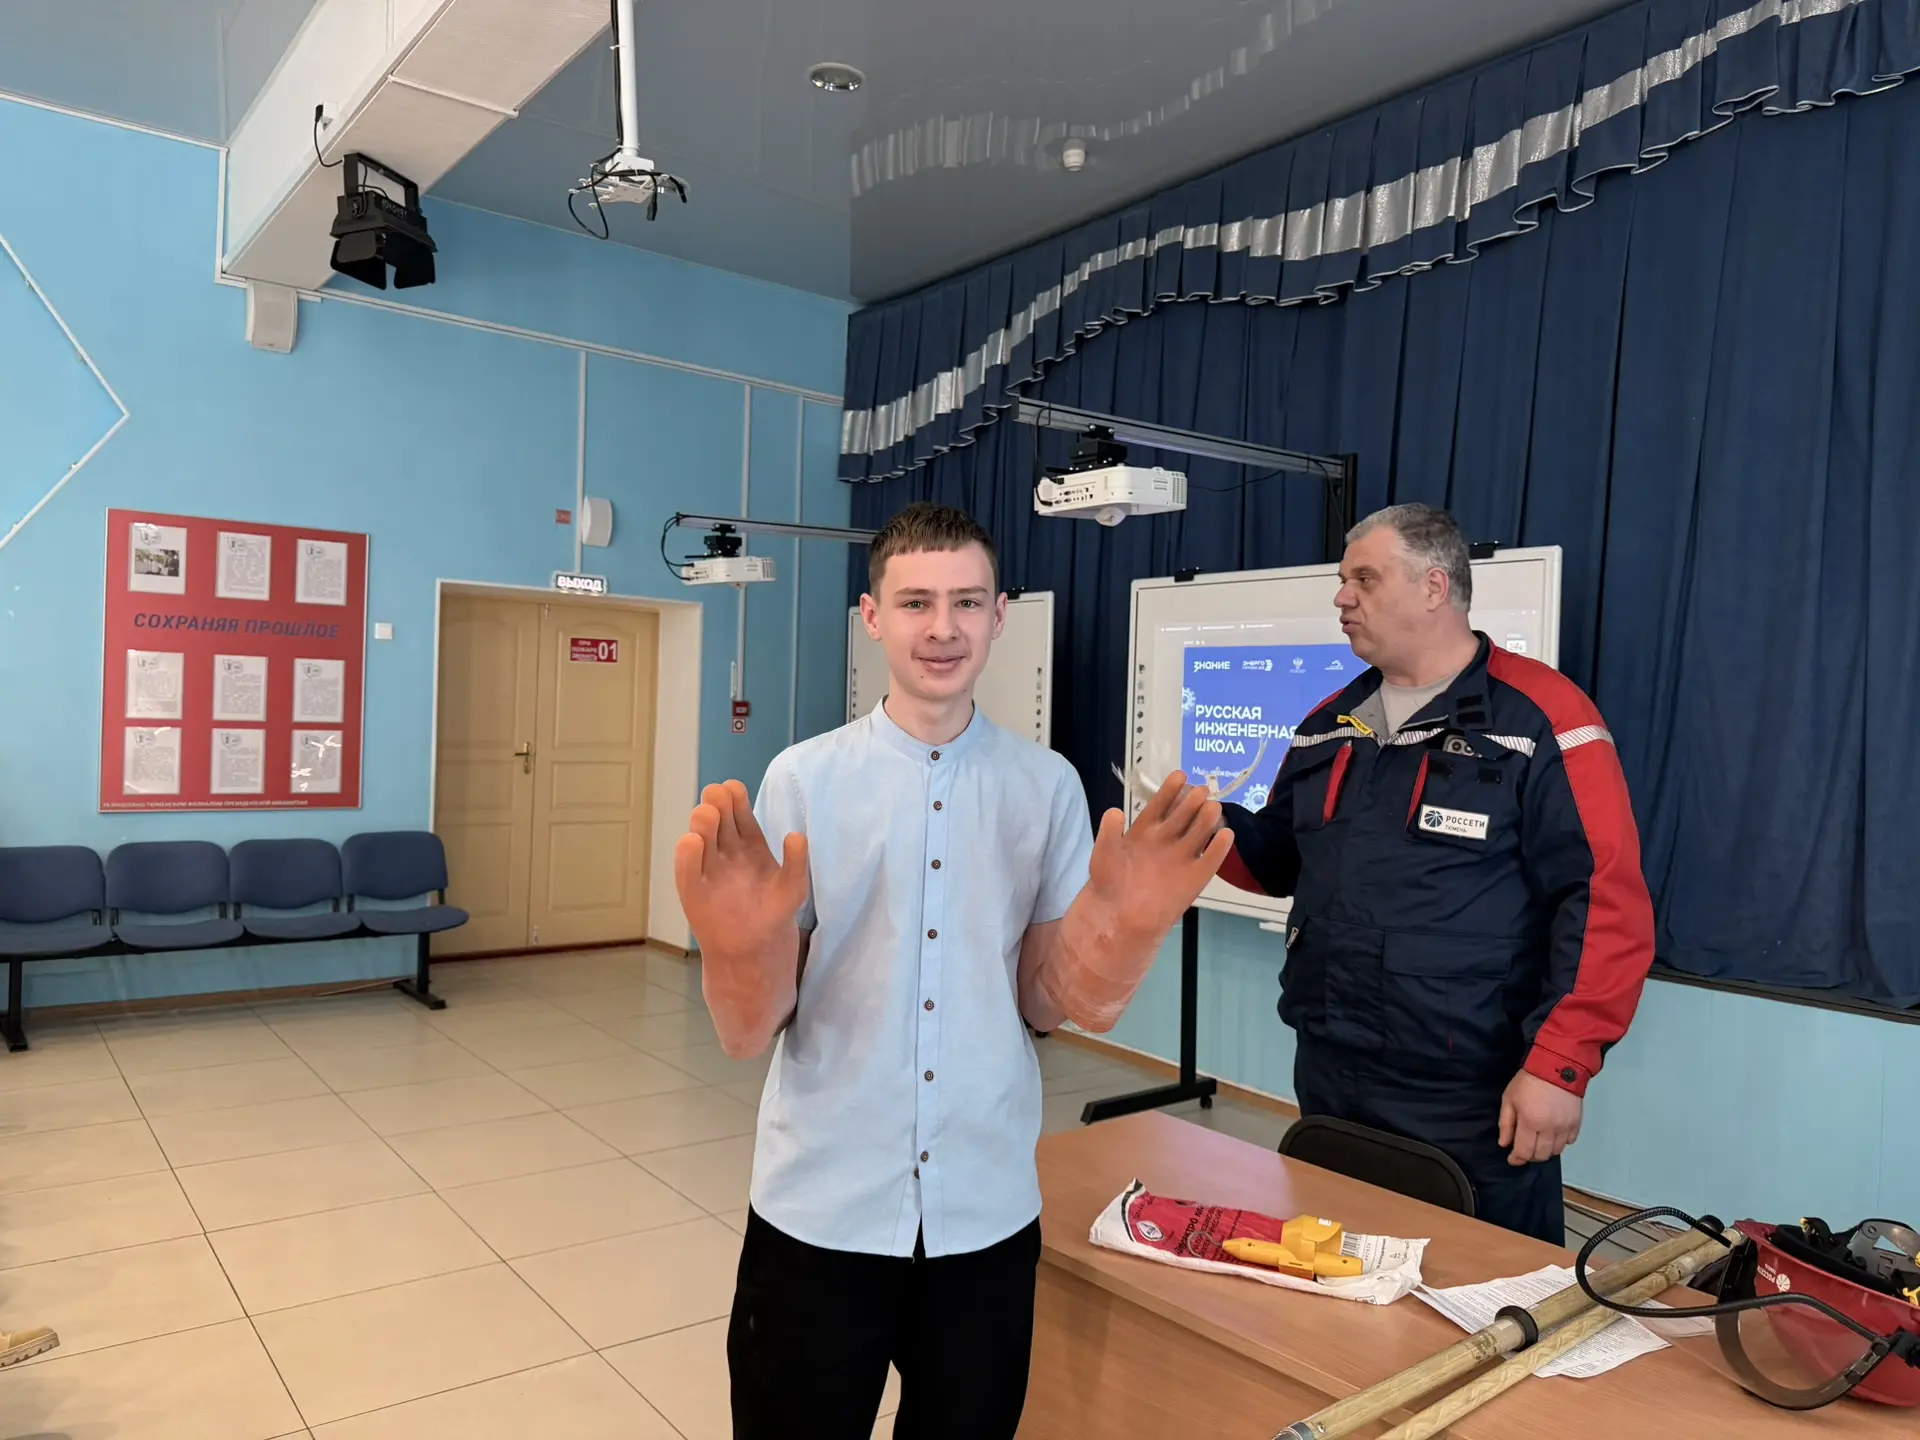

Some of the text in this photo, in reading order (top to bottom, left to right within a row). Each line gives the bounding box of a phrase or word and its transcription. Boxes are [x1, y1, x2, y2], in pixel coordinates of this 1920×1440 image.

[557, 576, 602, 591] ВЫХОД
[133, 612, 340, 639] СОХРАНЯЯ ПРОШЛОЕ
[598, 641, 617, 661] 01
[1195, 704, 1262, 720] РУССКАЯ
[1194, 738, 1245, 754] ШКОЛА
[1445, 824, 1468, 833] ТЮМЕНЬ
[1446, 815, 1485, 828] РОССЕТИ
